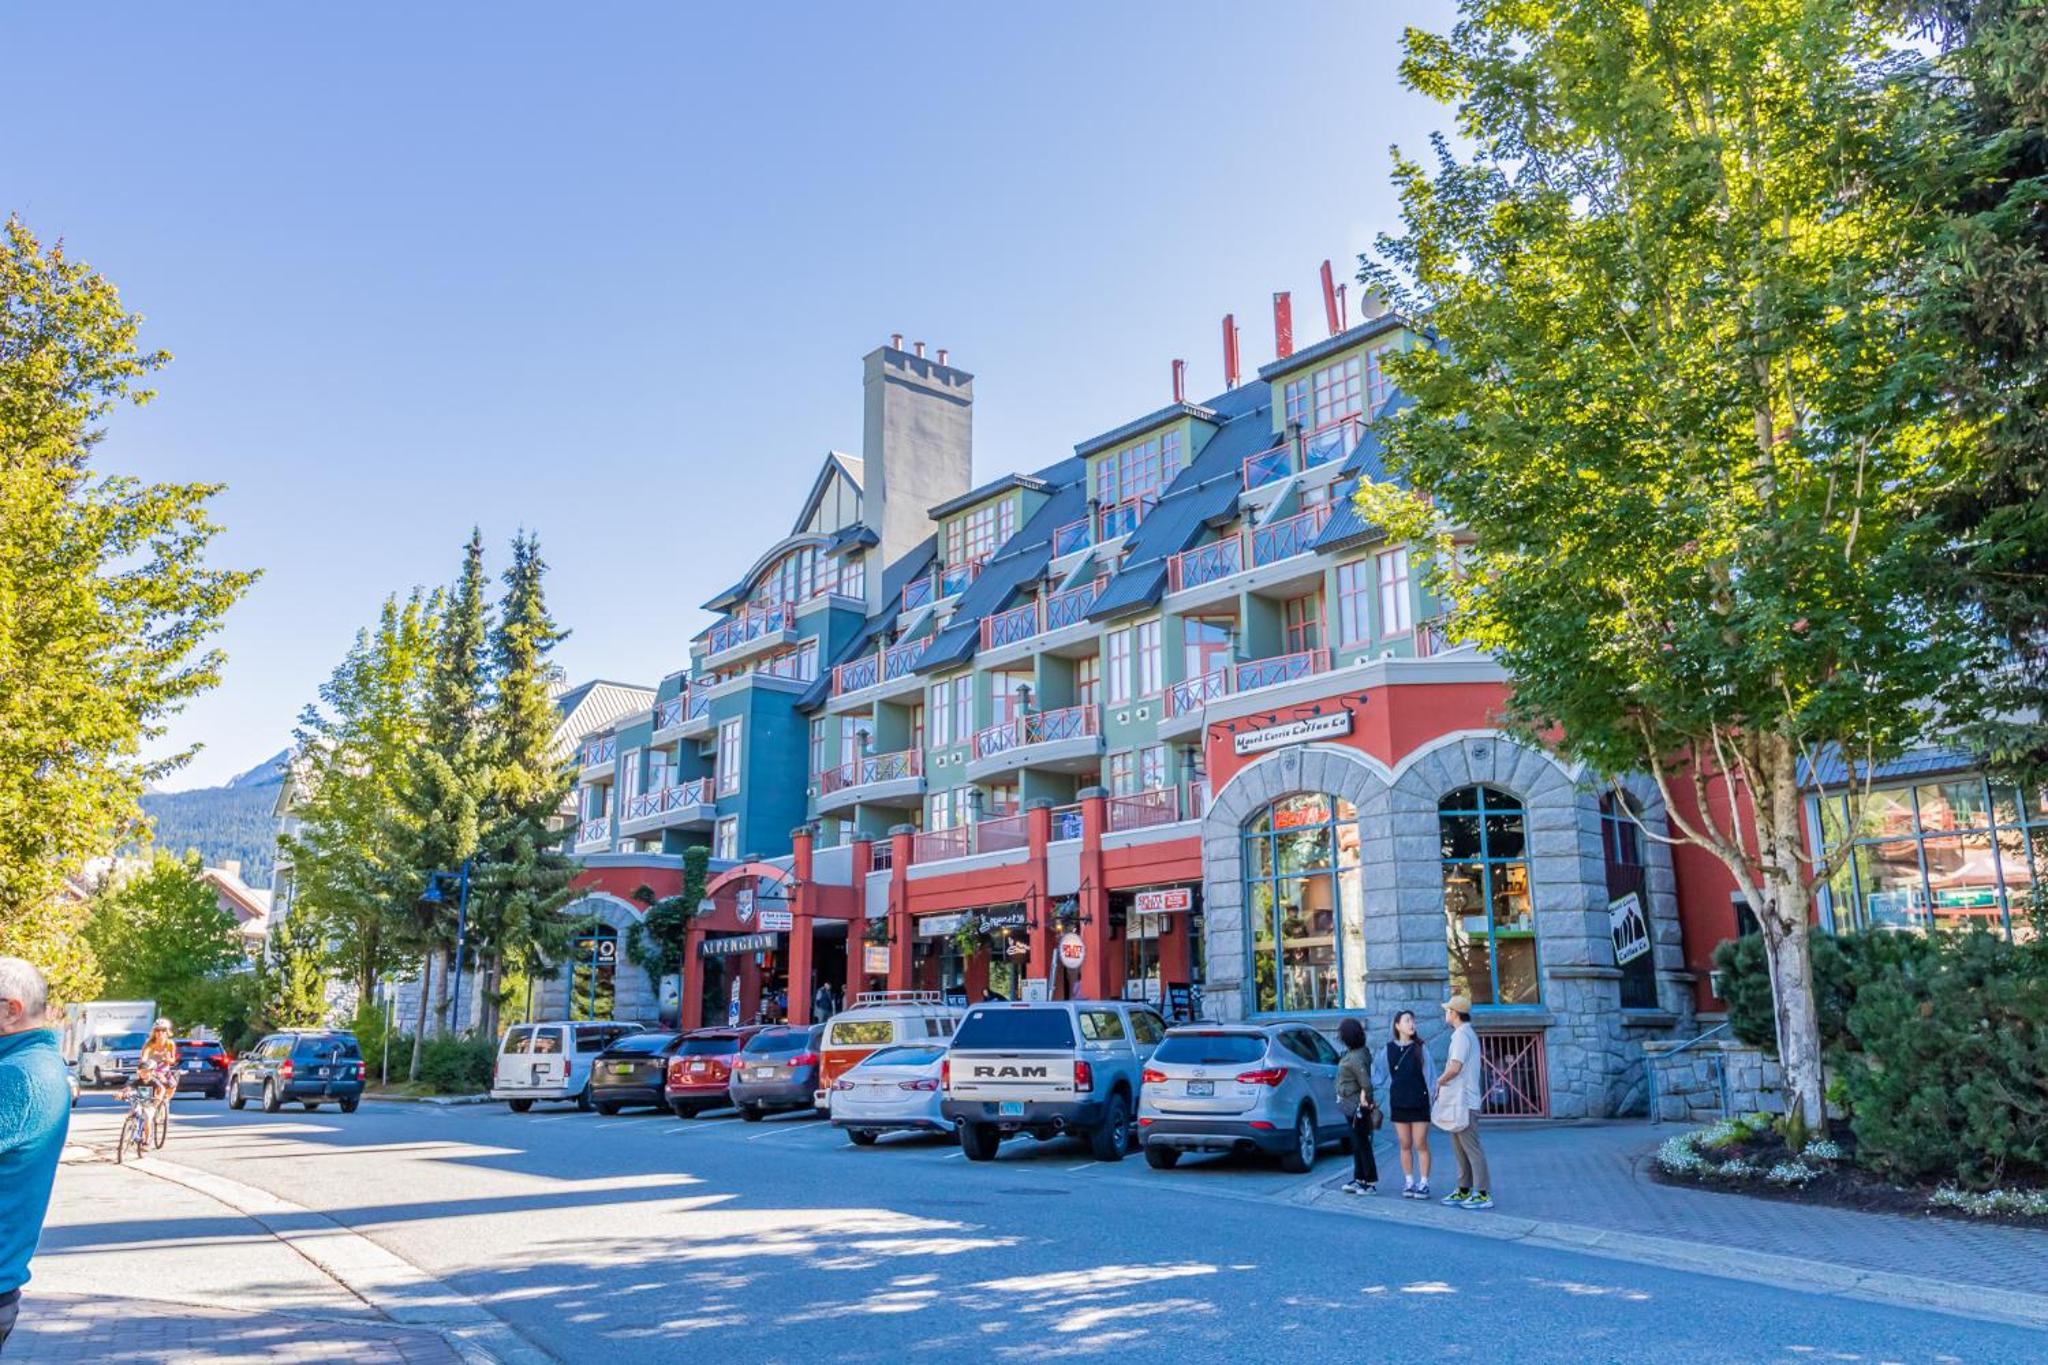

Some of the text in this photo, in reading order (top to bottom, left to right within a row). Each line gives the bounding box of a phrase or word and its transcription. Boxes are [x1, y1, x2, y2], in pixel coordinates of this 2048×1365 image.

[1264, 729, 1290, 742] Currie
[1292, 721, 1329, 736] Coffee
[1331, 717, 1346, 728] Co
[974, 1066, 1047, 1077] RAM
